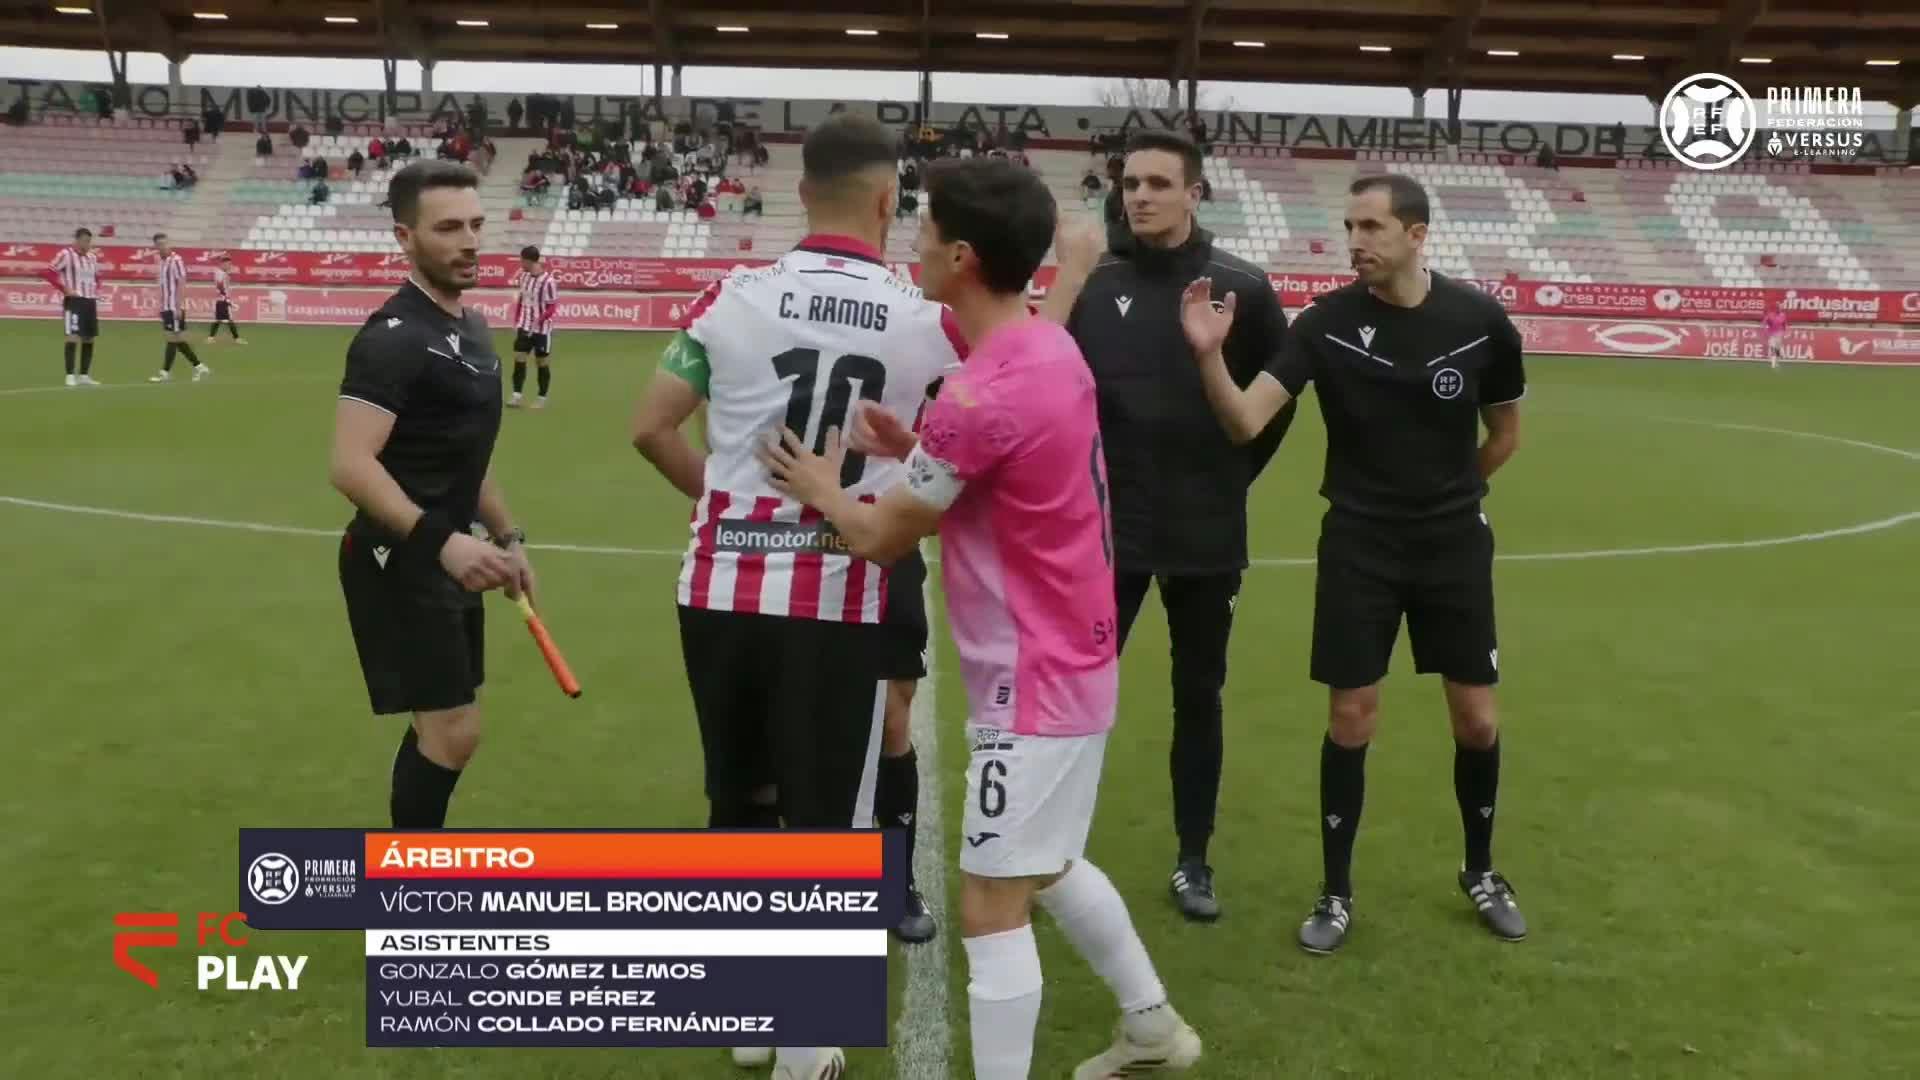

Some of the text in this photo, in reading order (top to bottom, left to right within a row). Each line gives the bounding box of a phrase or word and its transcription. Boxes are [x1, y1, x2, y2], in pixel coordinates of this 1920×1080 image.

[603, 304, 641, 321] Chef
[779, 292, 888, 332] C. RAMOS
[1597, 295, 1647, 306] cruces
[1744, 343, 1763, 357] DE
[771, 347, 887, 488] 10
[716, 523, 850, 550] leomotor.ne
[980, 759, 1007, 818] 6
